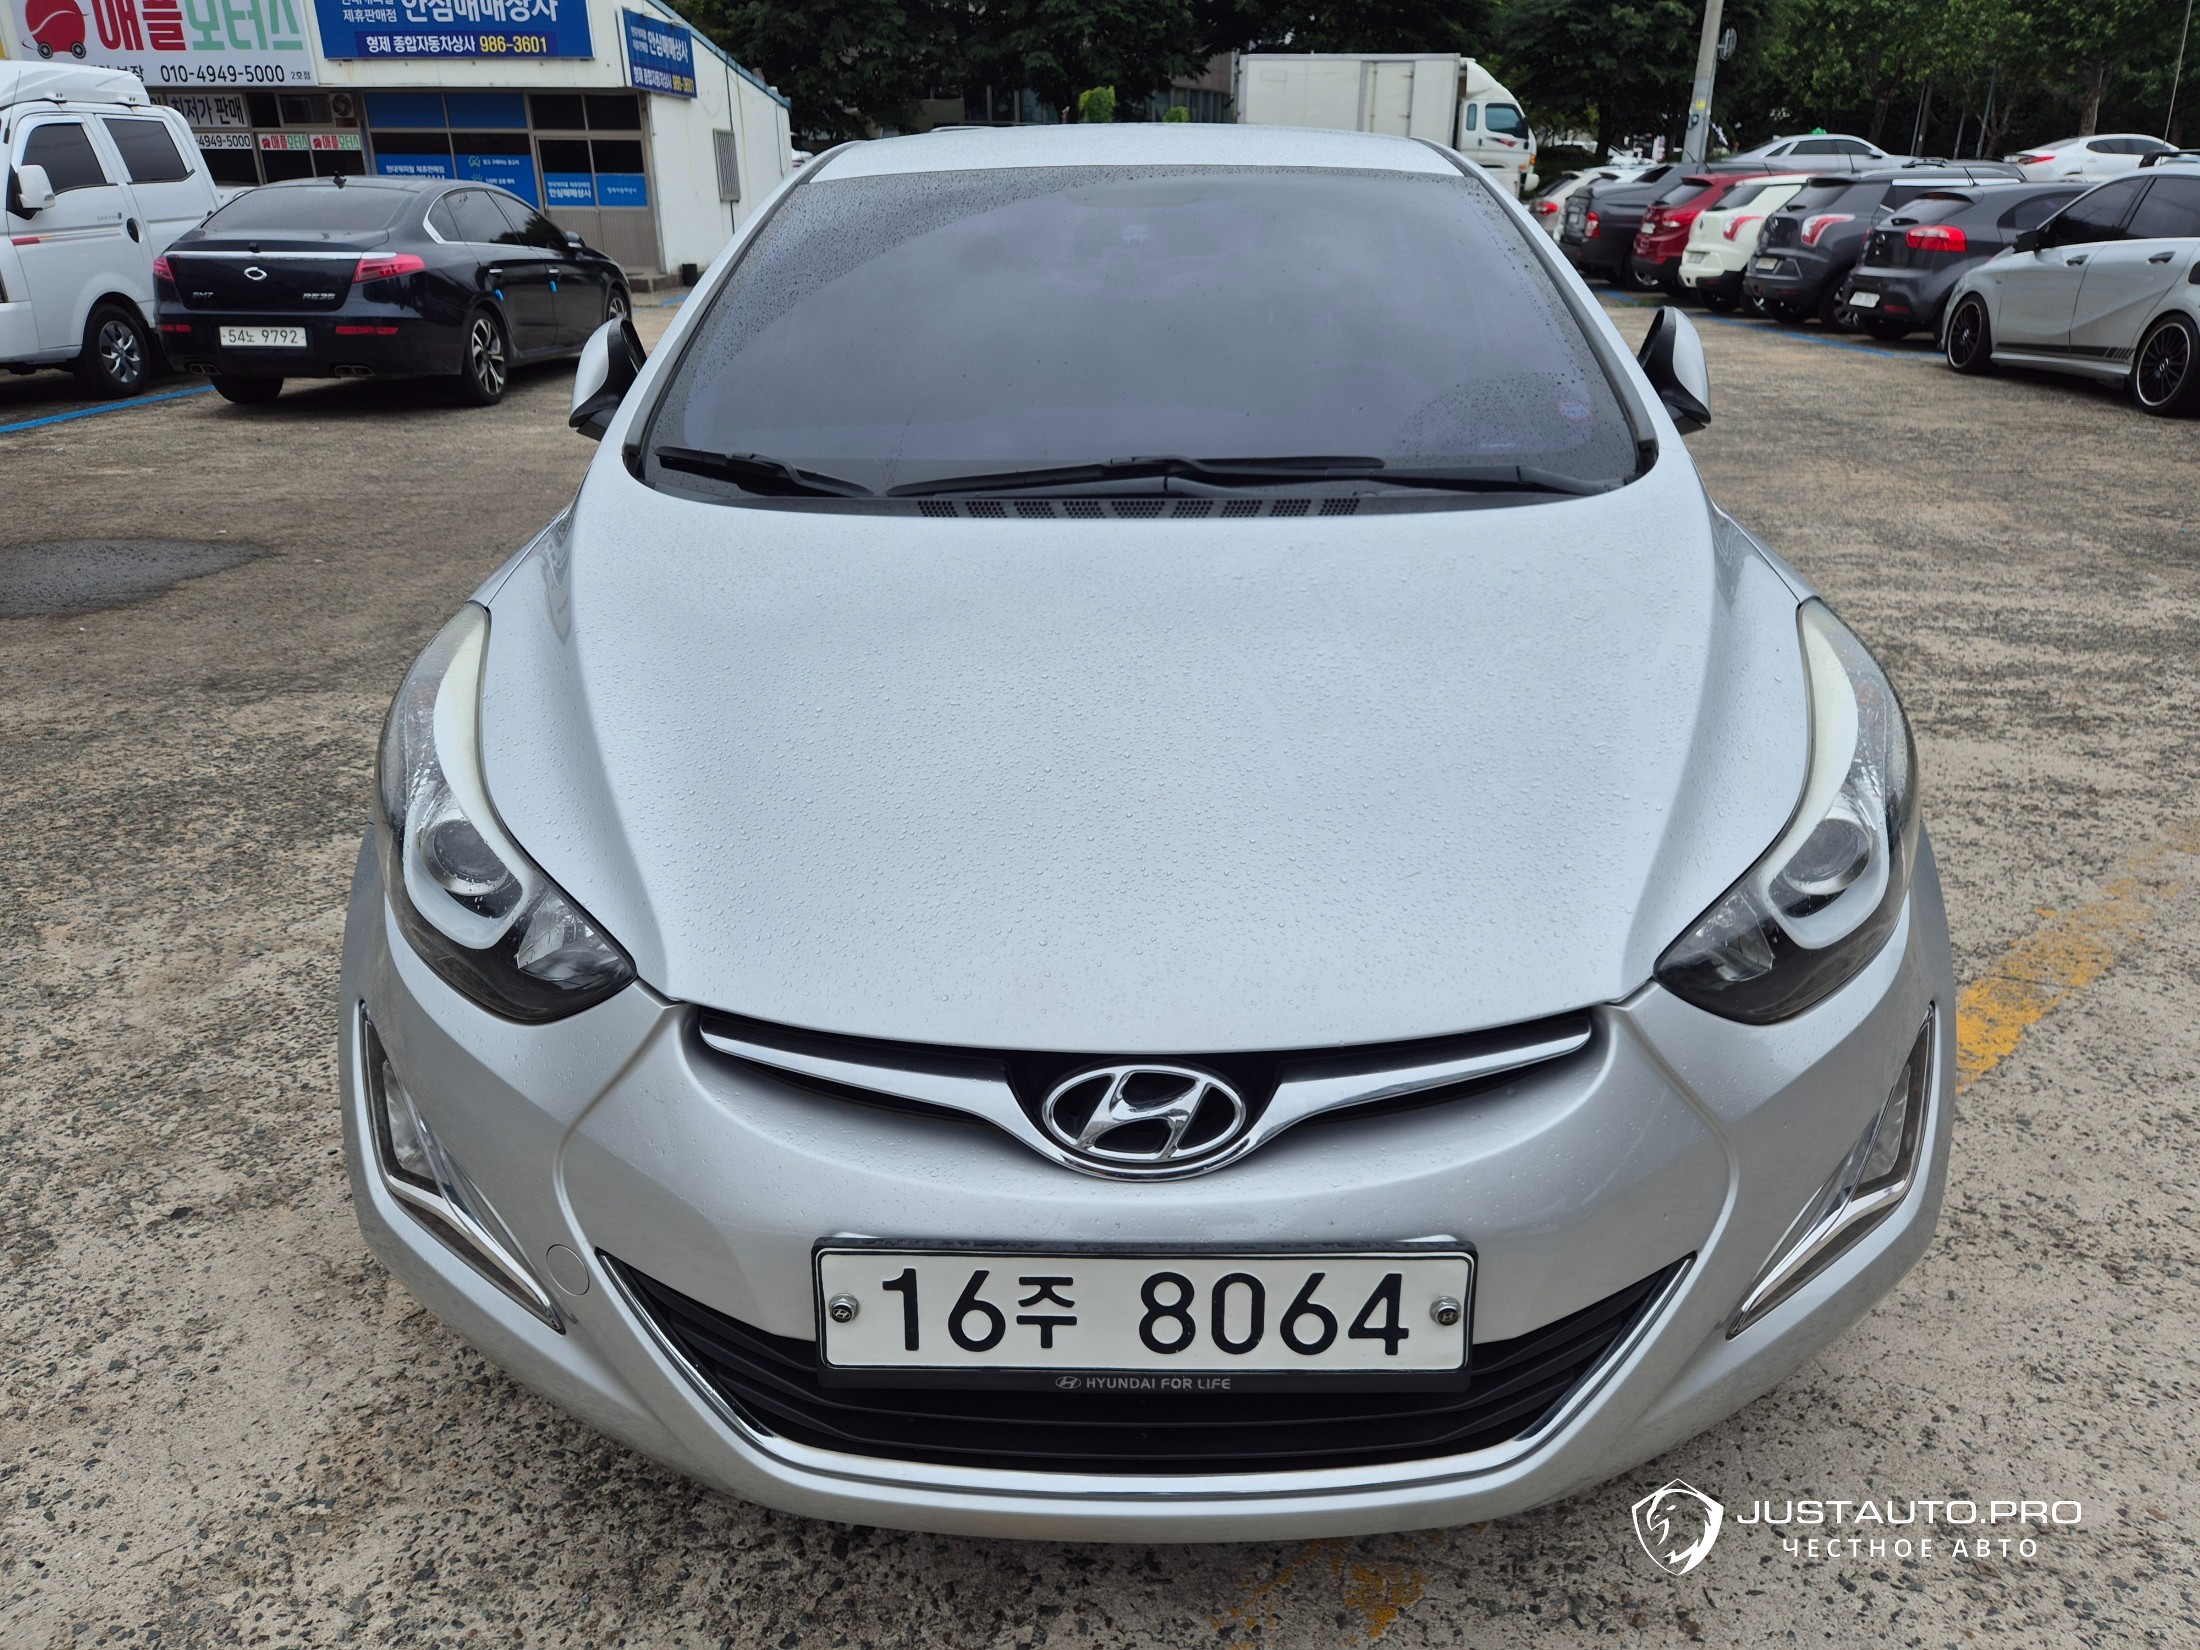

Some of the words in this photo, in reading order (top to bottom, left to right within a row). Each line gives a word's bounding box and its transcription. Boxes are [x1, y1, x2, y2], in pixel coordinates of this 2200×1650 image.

[343, 9, 398, 23] 제휴판매점
[403, 0, 558, 22] 안심매매상사
[366, 35, 391, 53] 형제
[393, 35, 475, 53] 종합자동차상사
[479, 36, 547, 53] 986-3601
[160, 65, 285, 83] 010-4949-5000
[214, 96, 245, 125] 판매
[195, 134, 250, 147] -4949-5000
[228, 329, 255, 343] 54노
[261, 329, 298, 344] 9792
[882, 1267, 1078, 1353] 16주
[1139, 1271, 1409, 1356] 8064
[1086, 1377, 1155, 1389] HYUNDAI
[1161, 1378, 1193, 1390] FOR
[1197, 1378, 1231, 1390] LIFE
